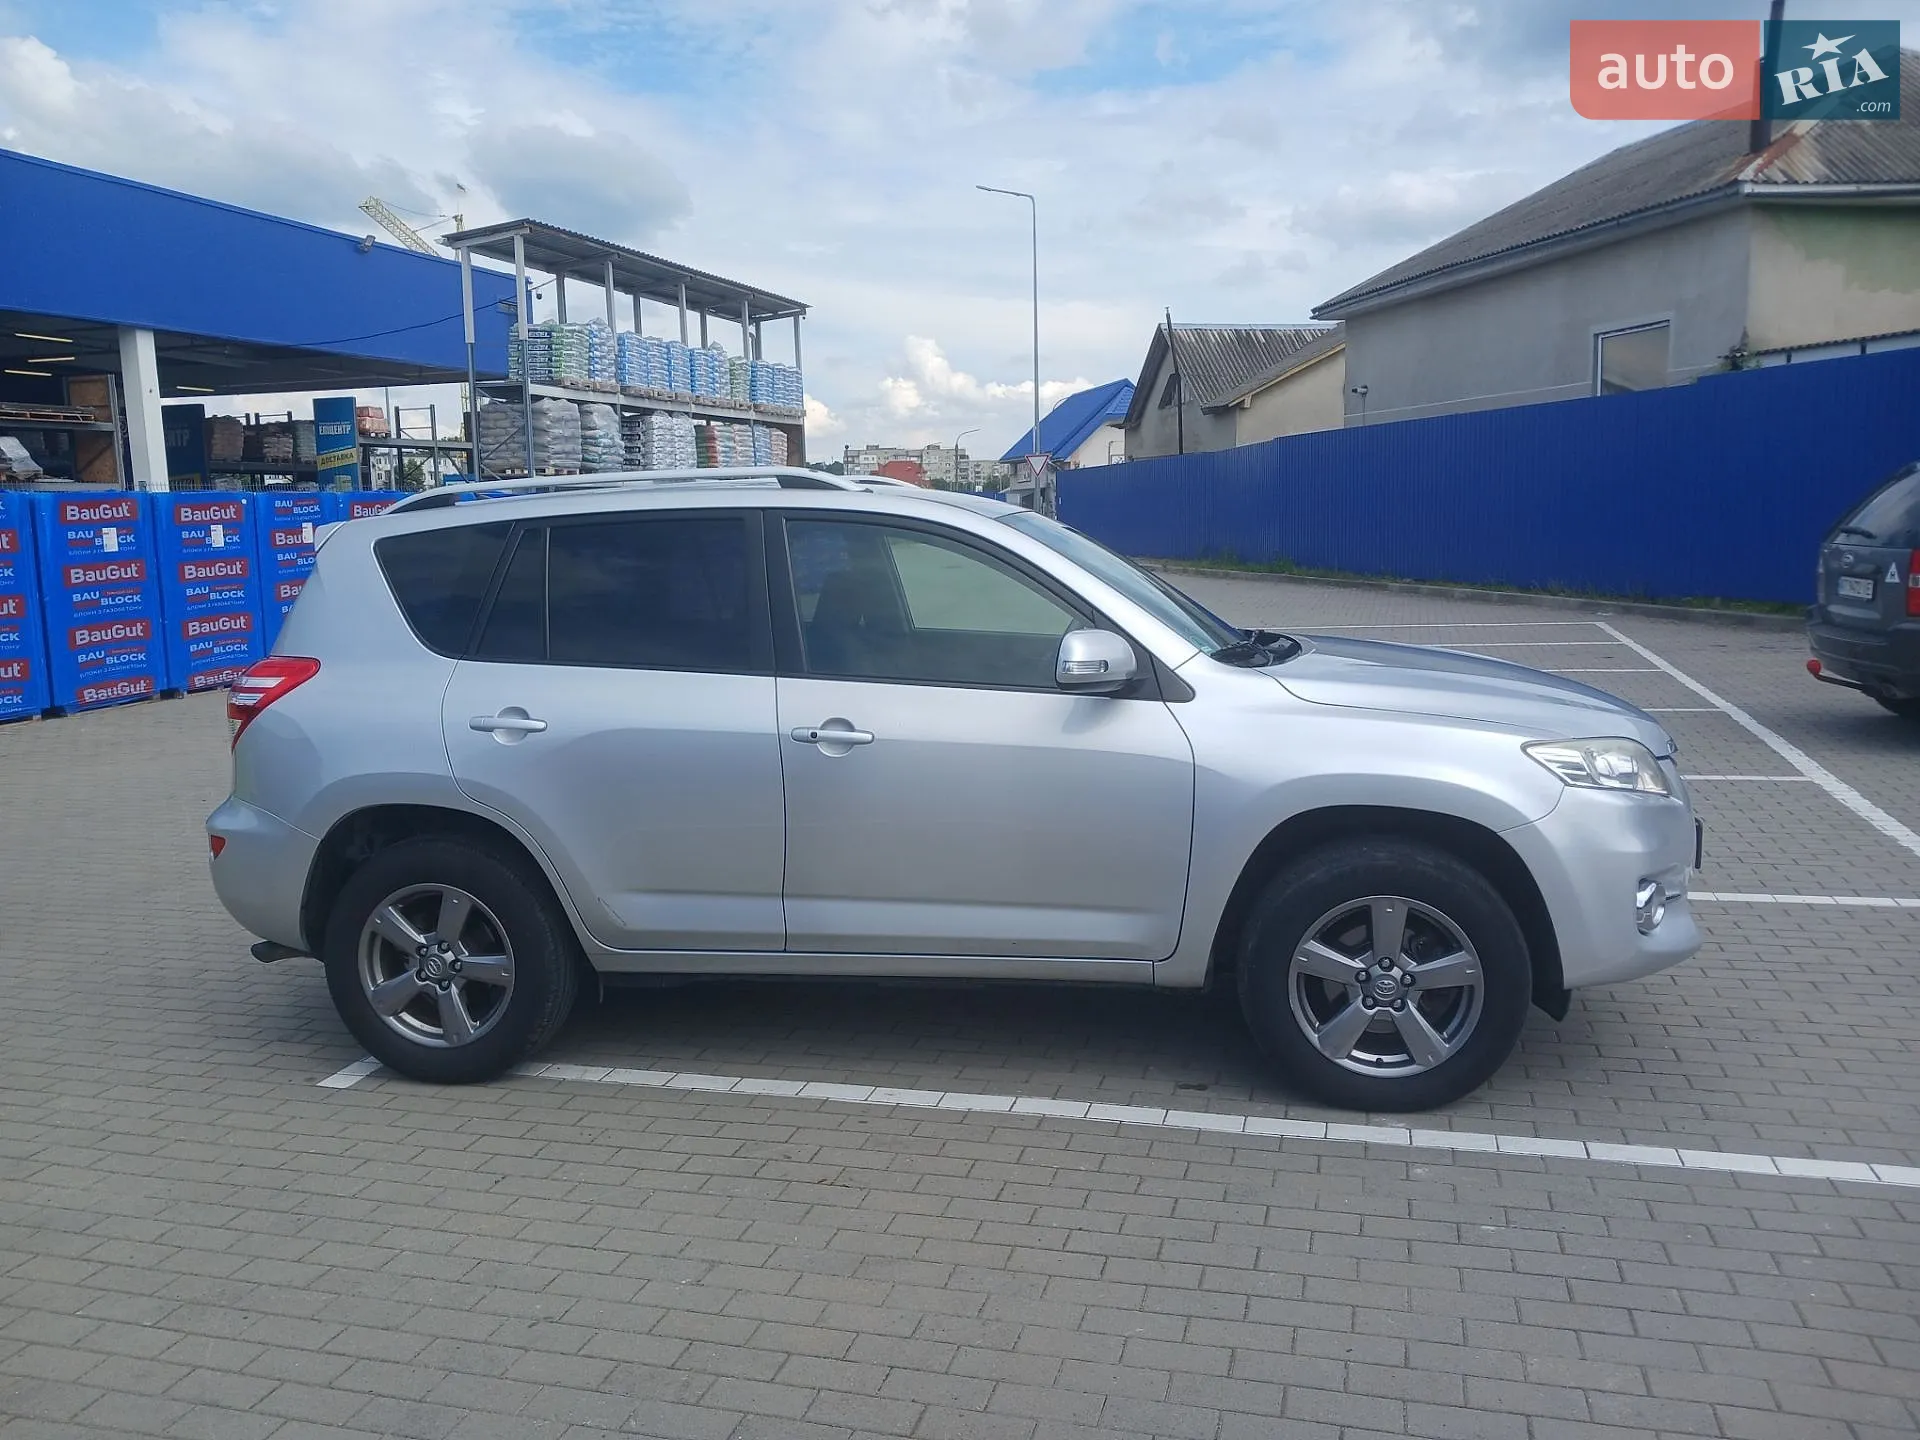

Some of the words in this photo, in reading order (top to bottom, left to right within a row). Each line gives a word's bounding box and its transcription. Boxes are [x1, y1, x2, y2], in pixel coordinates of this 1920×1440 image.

[66, 502, 131, 521] BauGut
[180, 505, 237, 521] BauGut
[274, 500, 293, 508] BAU
[293, 505, 320, 514] BLOCK
[354, 504, 392, 517] BauG
[67, 530, 94, 539] BAU
[95, 534, 136, 546] BCK
[181, 530, 204, 539] BAU
[205, 534, 240, 545] BCK
[275, 532, 304, 545] Bau
[277, 552, 297, 561] BAU
[297, 557, 315, 566] BLO
[70, 563, 139, 584] BauGut
[183, 561, 243, 579] BauGut
[72, 591, 99, 602] BAU
[100, 594, 142, 606] BLOCK
[186, 586, 209, 596] BAU
[210, 590, 246, 600] BLOCK
[75, 622, 144, 645] BauGut
[188, 616, 247, 636] BauGut
[190, 641, 213, 652] BAU
[213, 643, 248, 654] BLOCK
[77, 650, 105, 663] BAU
[106, 652, 146, 664] BLOCK
[83, 679, 148, 702] BauGut
